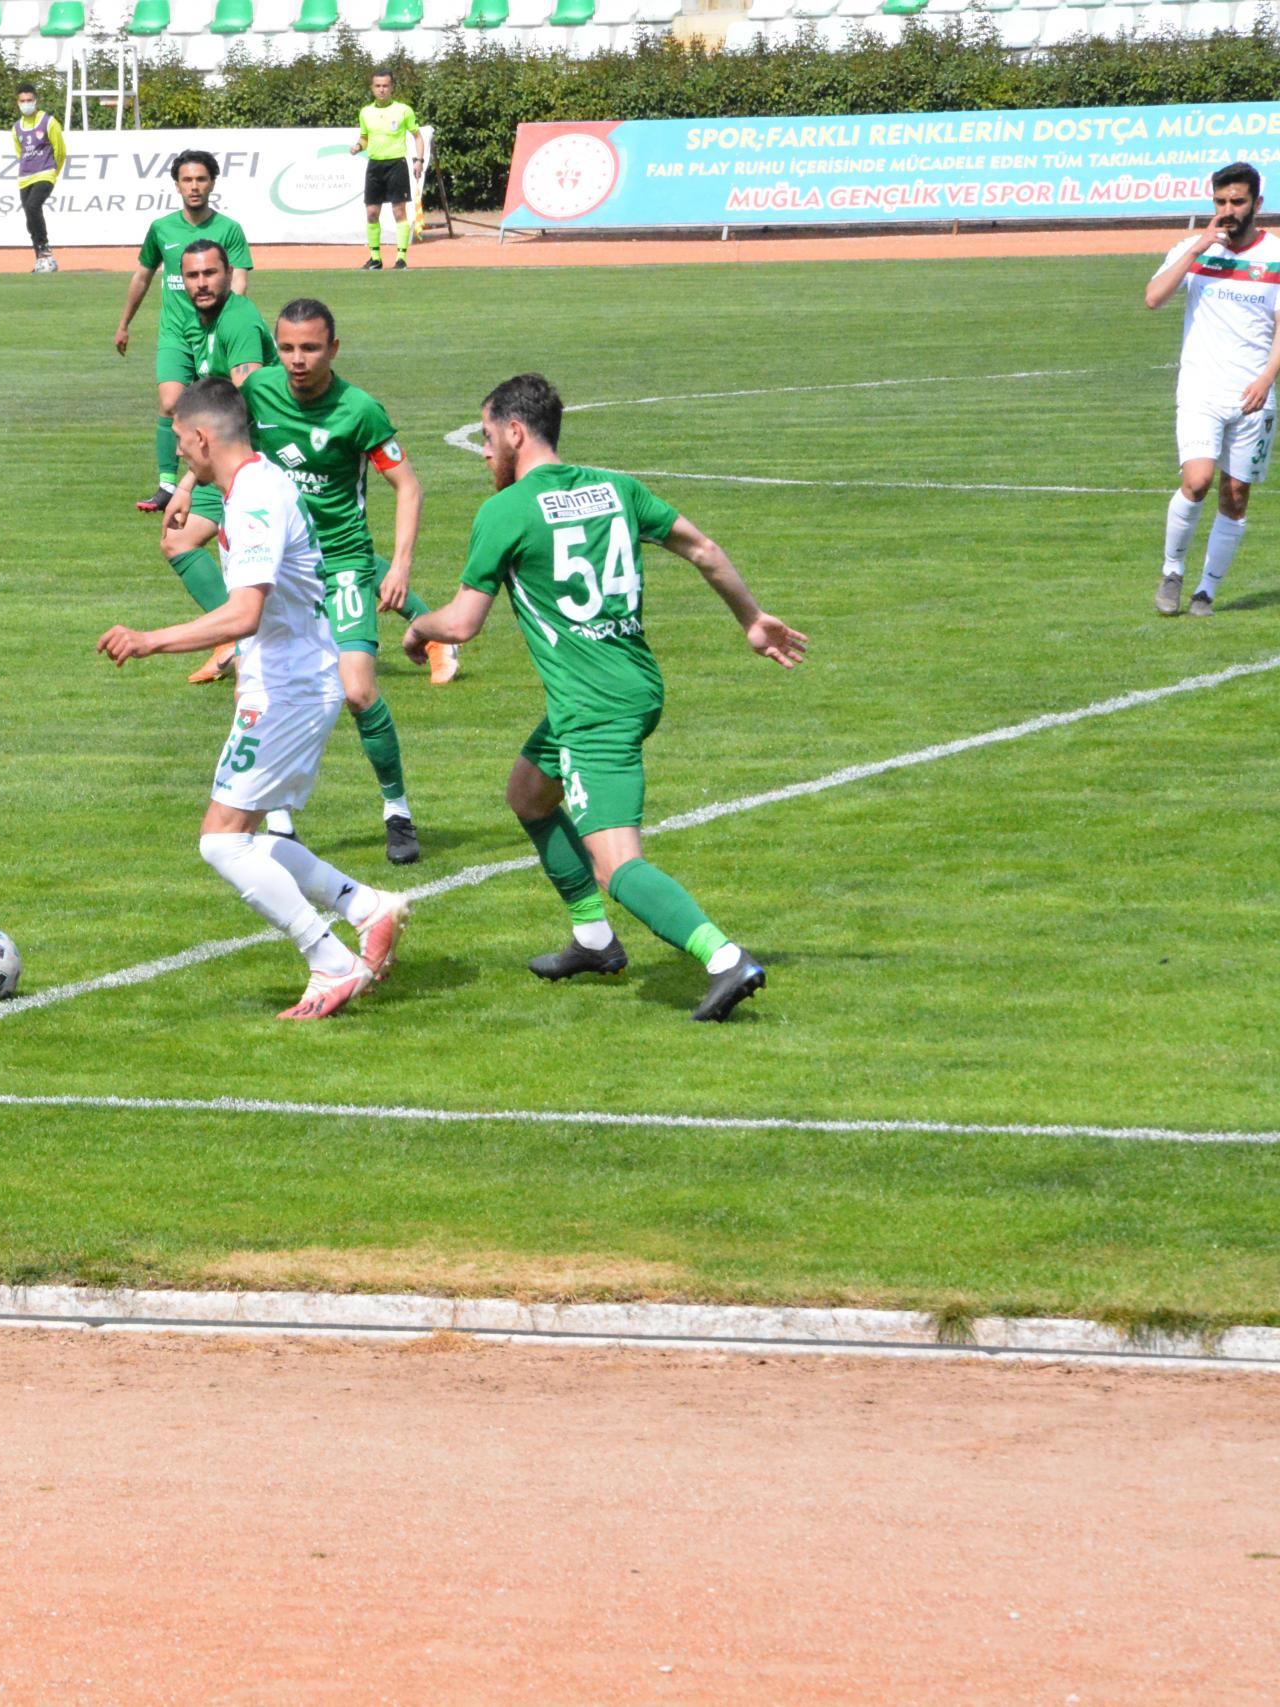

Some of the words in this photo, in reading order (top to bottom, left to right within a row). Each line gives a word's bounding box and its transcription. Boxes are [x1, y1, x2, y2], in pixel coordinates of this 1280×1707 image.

[686, 124, 860, 151] SPOR;FARKLI
[868, 115, 1025, 145] RENKLERİN
[1032, 116, 1149, 145] DOSTÇA
[132, 151, 260, 178] VAFI
[646, 163, 683, 177] FAIR
[688, 161, 732, 177] PLAY
[734, 160, 784, 176] RUHU
[789, 154, 887, 177] İÇERİSİNDE
[889, 153, 986, 173] MÜCADELE
[990, 155, 1037, 170] EDEN
[1043, 151, 1082, 168] TÜM
[1088, 148, 1232, 168] TAKIMLARIMIZA
[135, 188, 229, 211] DİLR.
[727, 181, 822, 210] MUĞLA
[829, 180, 940, 211] GENÇLİK
[946, 184, 978, 204] VE
[984, 183, 1053, 204] SPOR
[1059, 178, 1081, 202] İL
[1090, 174, 1215, 201] MÜDÜRL
[1218, 288, 1265, 304] bitexen
[553, 516, 642, 622] 54
[331, 584, 363, 620] 10
